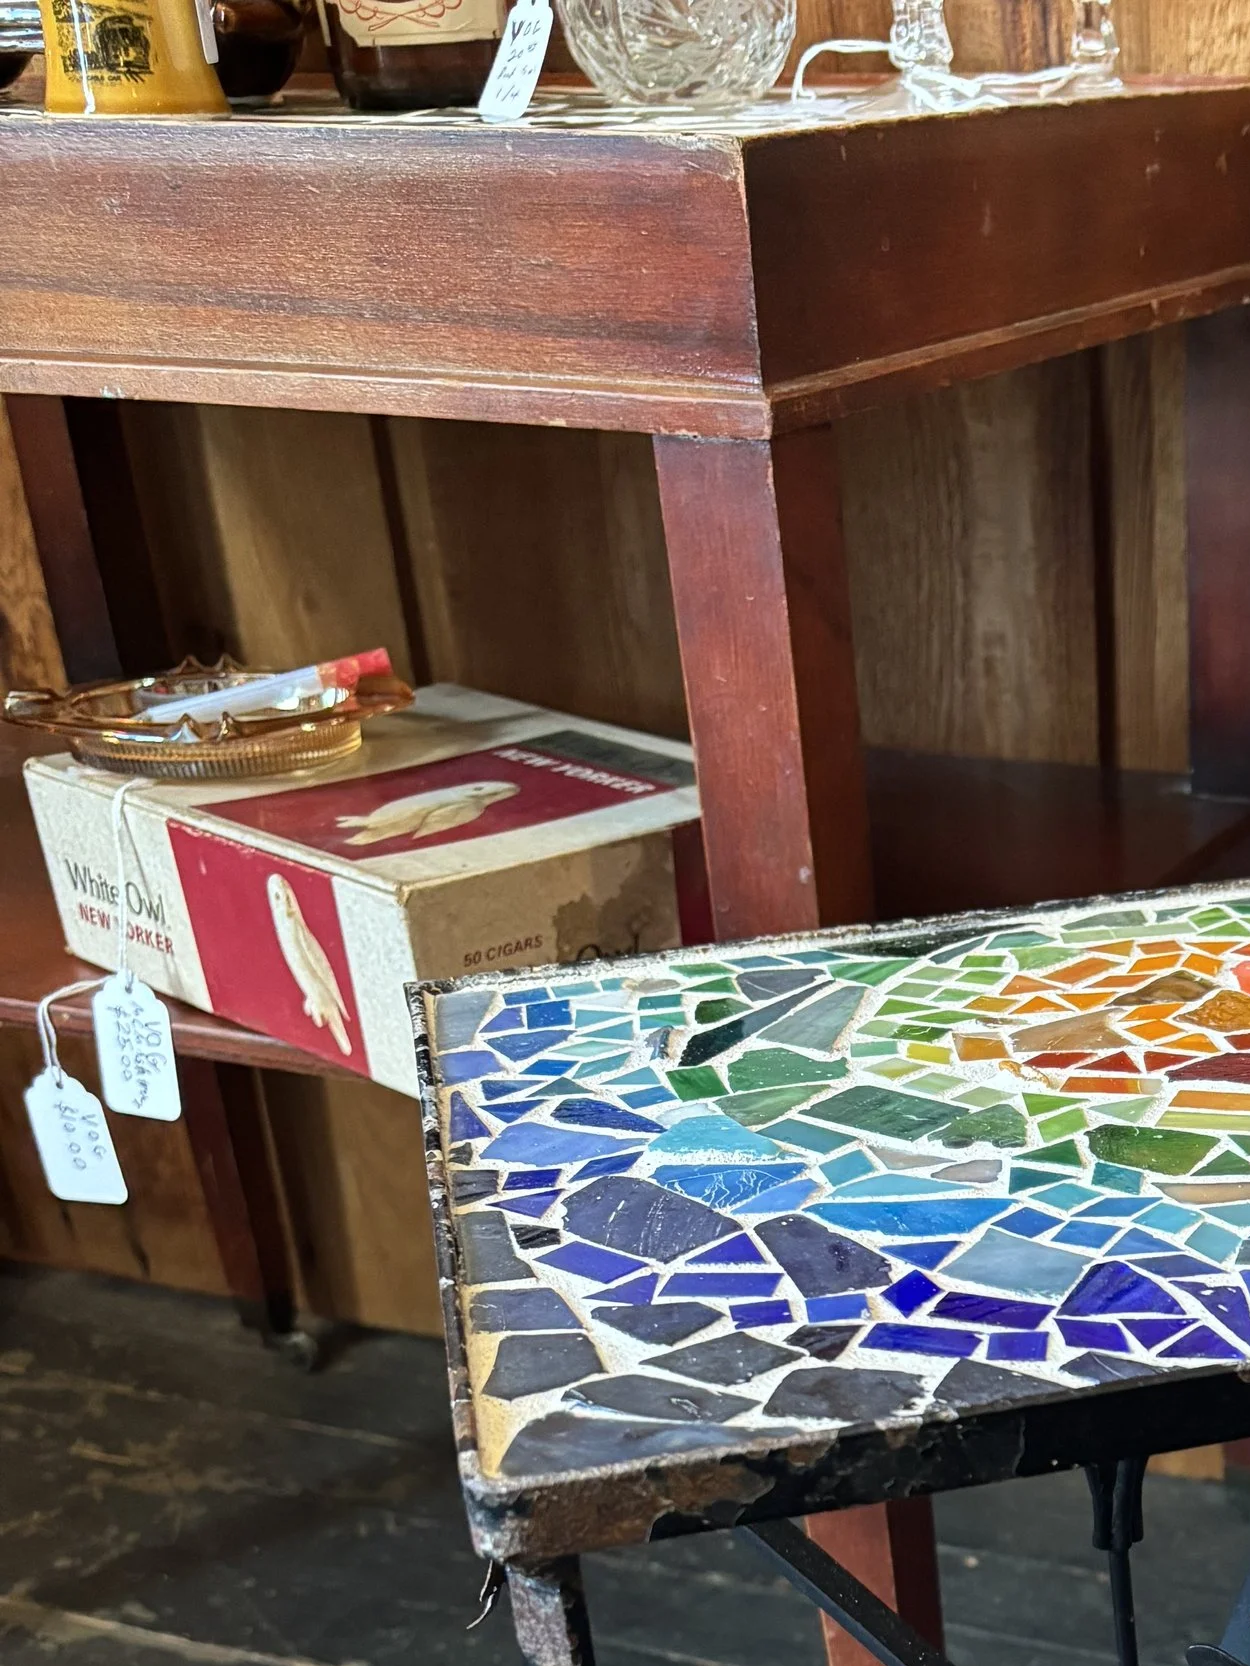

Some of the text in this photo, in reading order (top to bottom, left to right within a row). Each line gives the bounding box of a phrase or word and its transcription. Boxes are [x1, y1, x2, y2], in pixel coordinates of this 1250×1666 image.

[493, 748, 561, 768] NEW
[551, 763, 657, 795] YORKER
[65, 858, 166, 926] White Owl
[79, 901, 111, 931] NEW
[463, 934, 544, 968] 50 CIGARS
